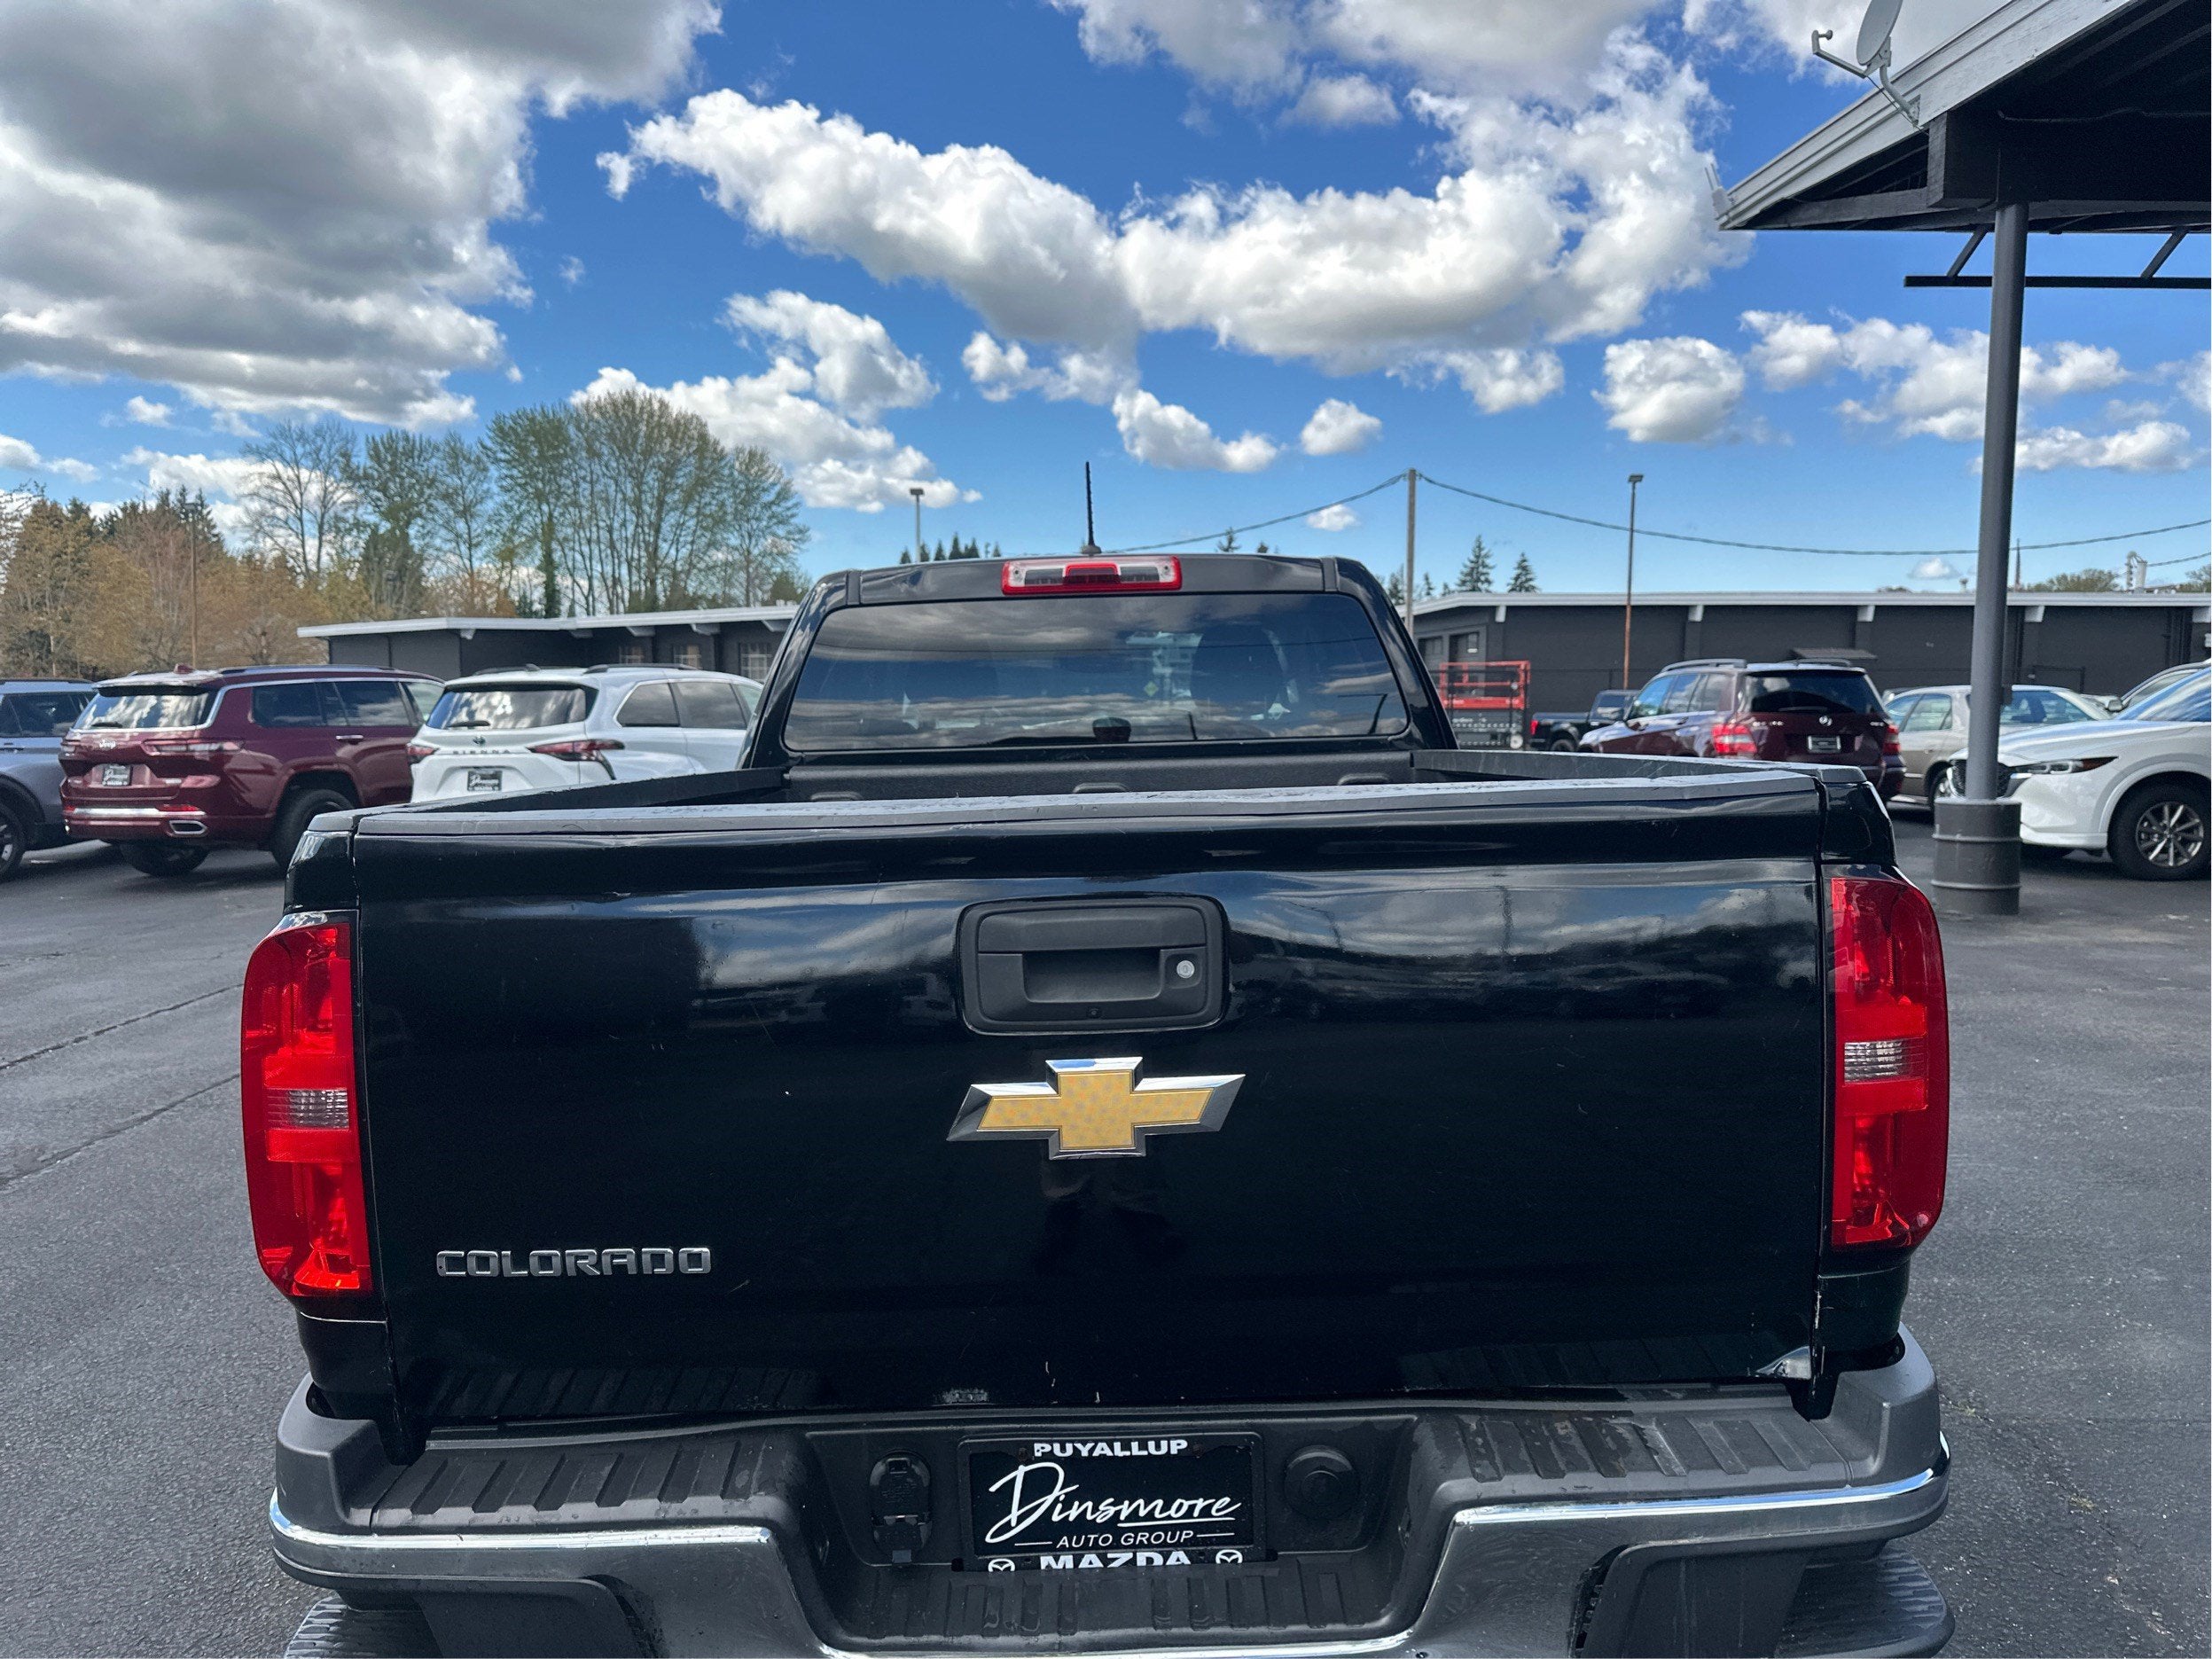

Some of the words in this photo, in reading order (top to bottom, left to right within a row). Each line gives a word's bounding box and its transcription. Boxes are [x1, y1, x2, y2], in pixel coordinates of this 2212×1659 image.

[437, 1248, 711, 1277] COLORADO
[1034, 1439, 1188, 1457] PUYALLUP
[985, 1462, 1241, 1543] Dinsmore
[1056, 1534, 1114, 1548] AUTO
[1121, 1530, 1194, 1546] GROUP
[1040, 1551, 1191, 1569] MAZDA
